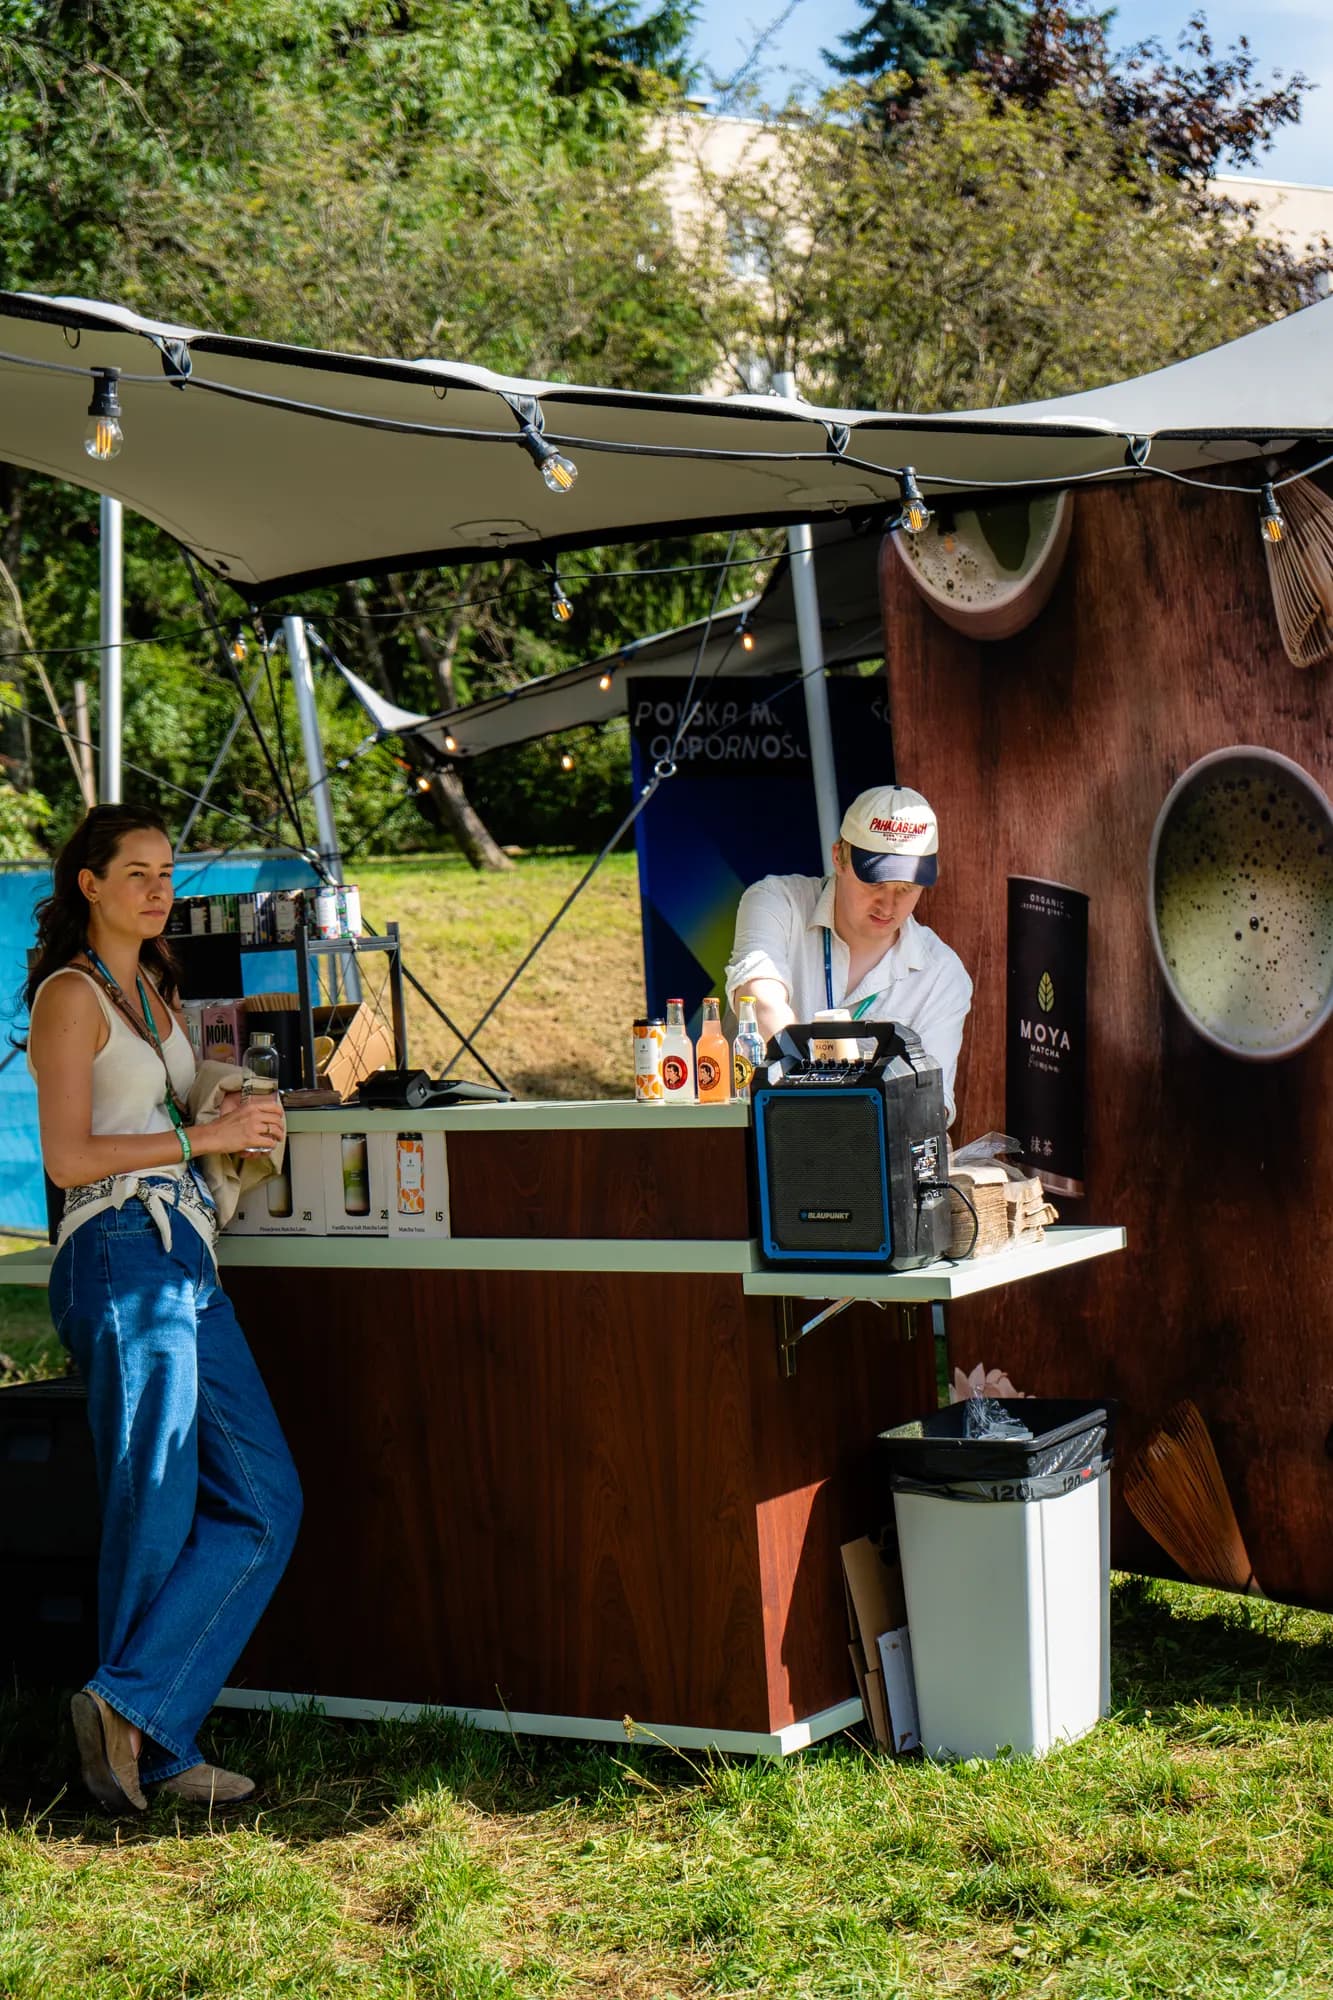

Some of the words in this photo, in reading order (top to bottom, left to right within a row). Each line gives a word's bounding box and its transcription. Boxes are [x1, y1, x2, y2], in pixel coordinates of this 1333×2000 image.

[1029, 893, 1065, 909] ORGANIC
[205, 1023, 236, 1047] MOMA
[1020, 1018, 1071, 1051] MOYA
[1029, 1043, 1061, 1059] MATCHA
[435, 1211, 444, 1222] 15
[808, 1211, 849, 1220] BLAUPUNKT
